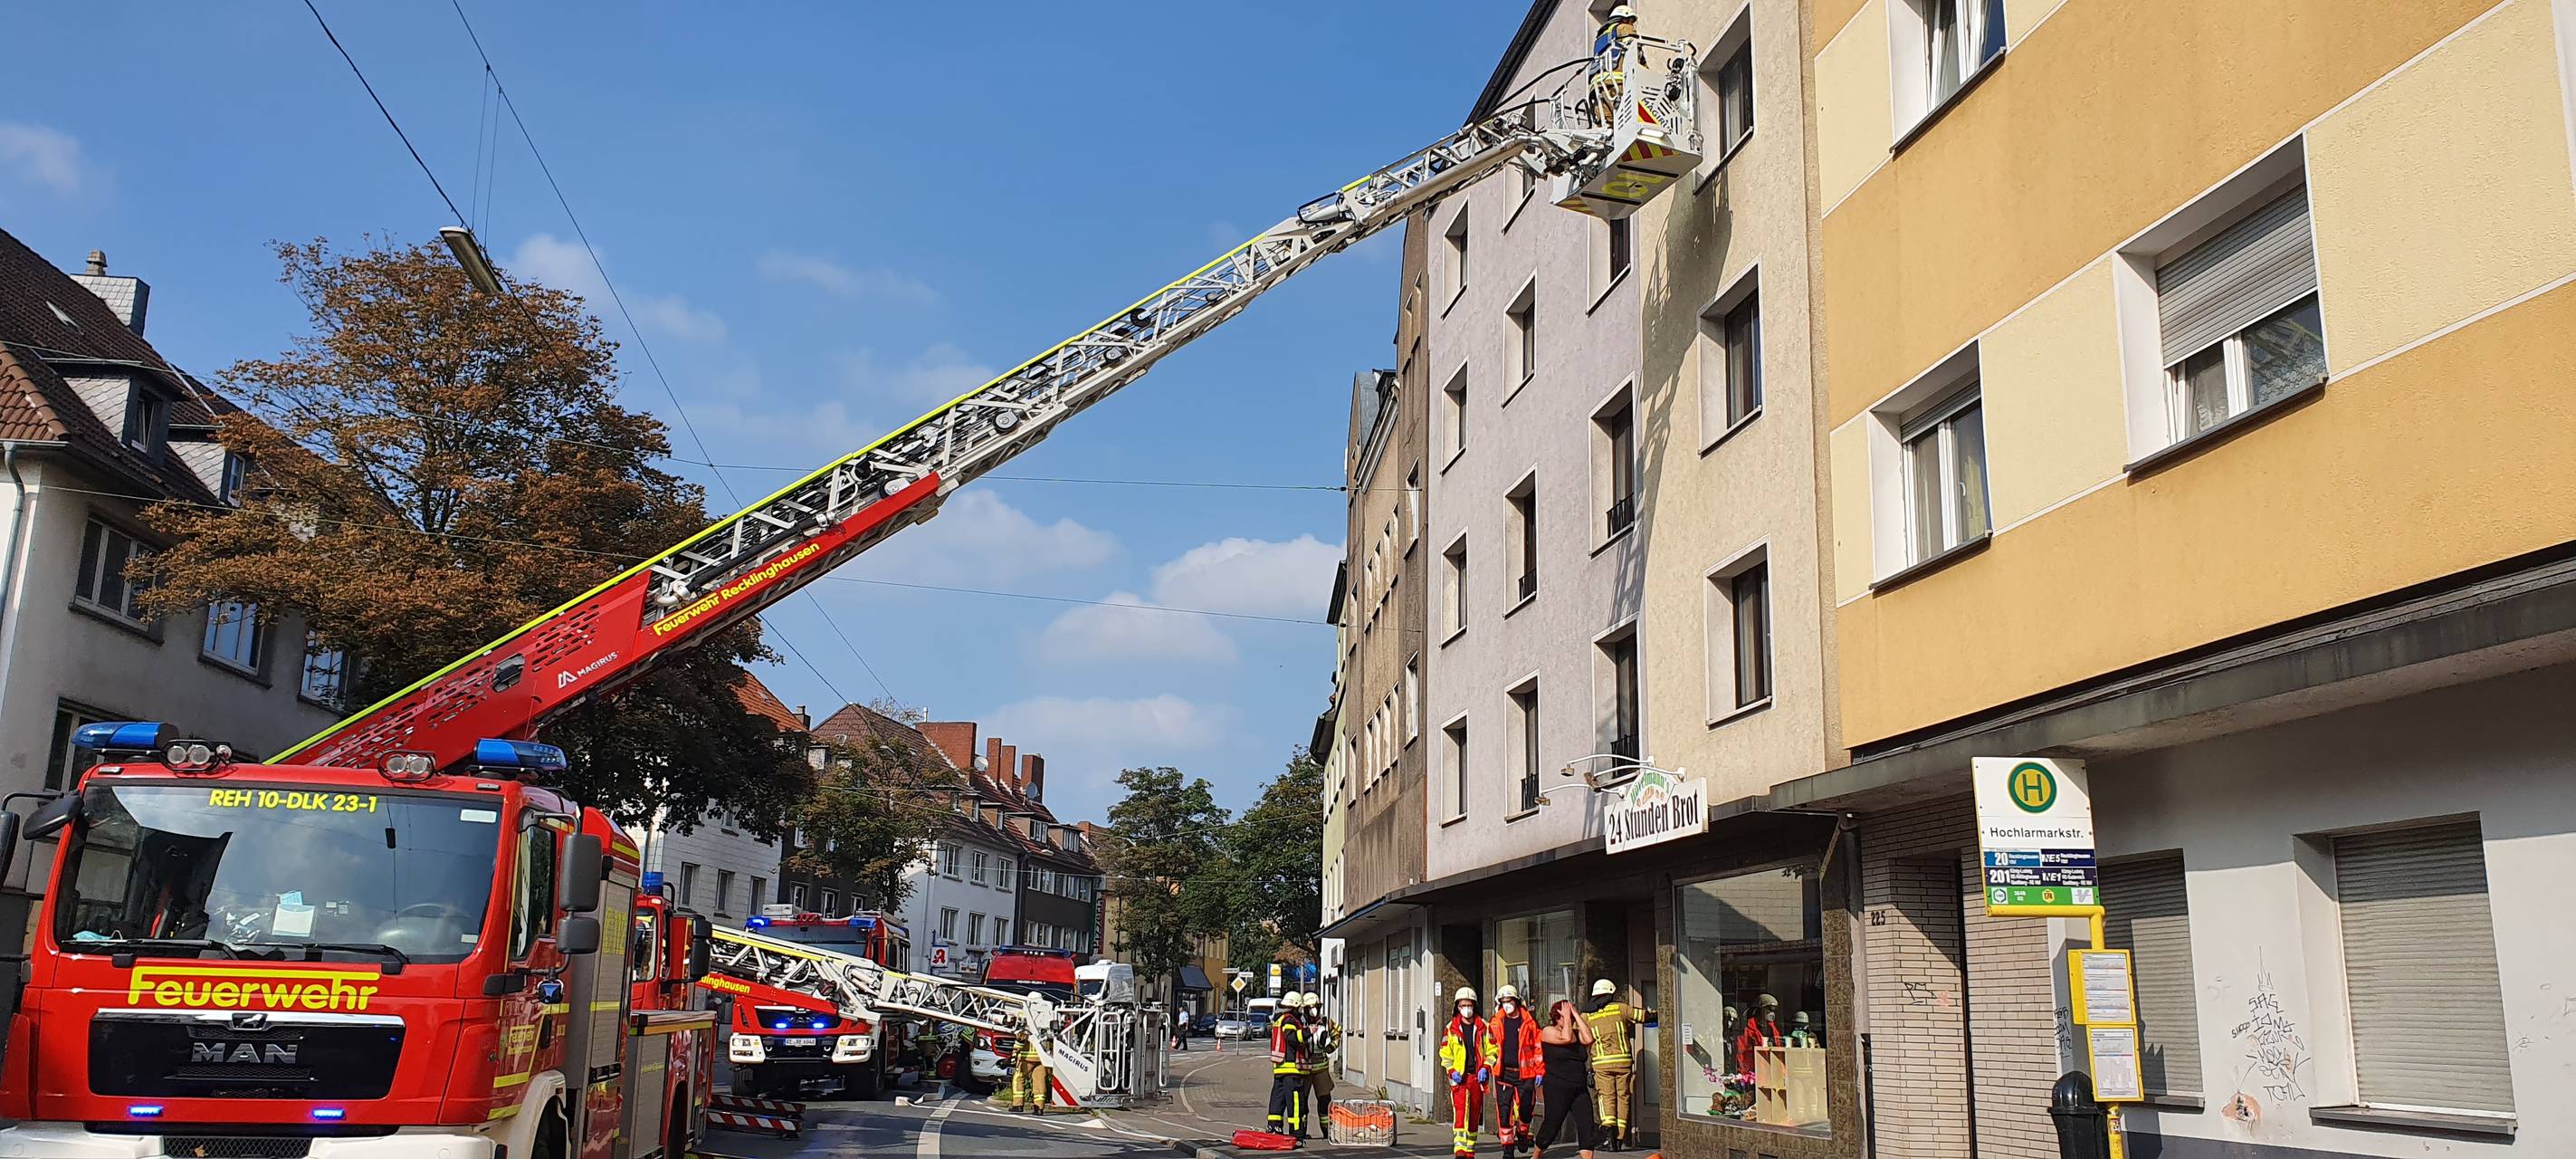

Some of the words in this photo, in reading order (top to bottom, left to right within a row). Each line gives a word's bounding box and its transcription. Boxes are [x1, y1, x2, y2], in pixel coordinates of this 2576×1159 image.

[654, 592, 720, 637] Feuerwehr
[722, 542, 820, 600] Recklinghausen
[577, 651, 617, 678] MAGIRUS
[2022, 773, 2043, 801] H
[209, 790, 253, 807] REH
[258, 791, 329, 810] 10-DLK
[332, 794, 377, 813] 23-1
[1609, 810, 1622, 845] 24
[1625, 802, 1669, 840] Stunden
[1672, 790, 1699, 829] Brot
[1989, 827, 2085, 838] Hochlarmarkstr.
[1994, 853, 2008, 866] 20
[1989, 869, 2010, 884] 201
[1870, 910, 1886, 925] 225
[127, 966, 380, 1011] Feuerwehr
[191, 1042, 298, 1064] MAN
[1058, 1048, 1089, 1072] MAGIRUS
